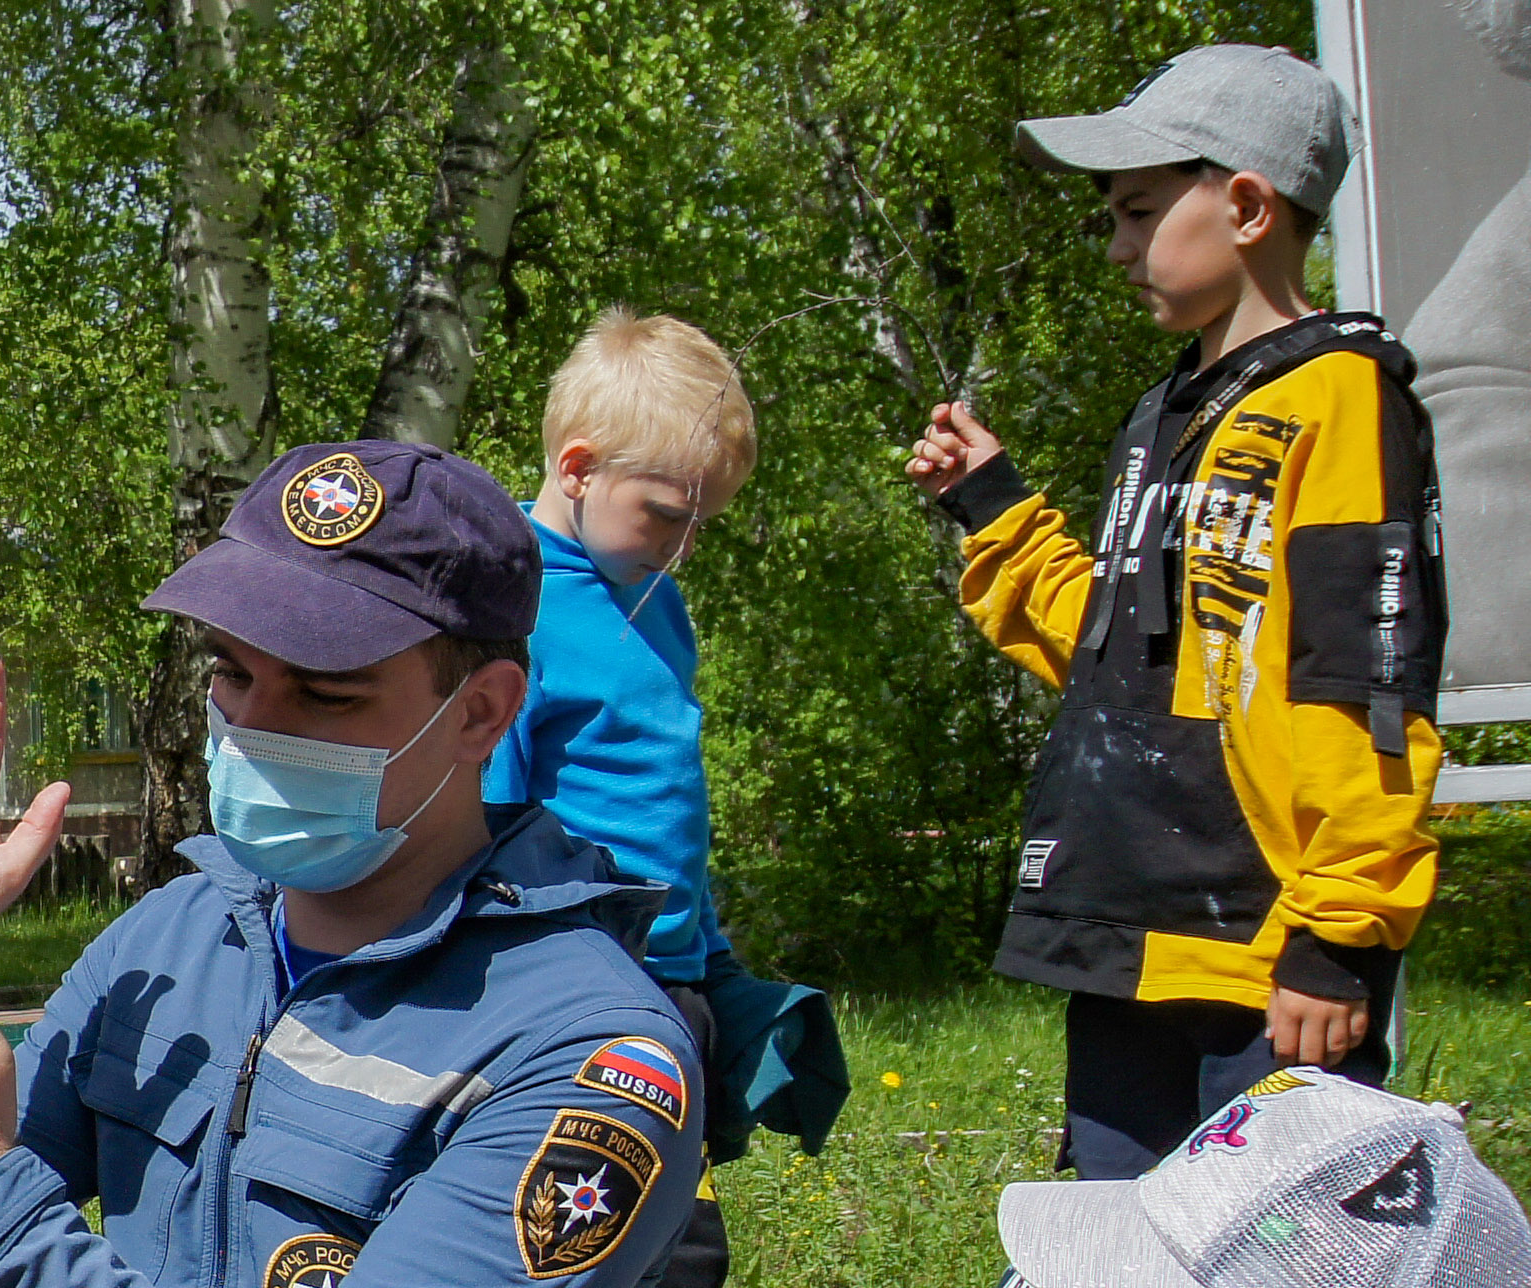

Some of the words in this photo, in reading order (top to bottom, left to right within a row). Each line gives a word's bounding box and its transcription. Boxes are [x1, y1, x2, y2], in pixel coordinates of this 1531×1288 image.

[307, 460, 337, 479] МЧС
[288, 490, 362, 538] EMERCOM
[600, 1066, 674, 1112] RUSSIA
[561, 1119, 604, 1141] МЧС
[606, 1130, 653, 1180] РОССИИ
[276, 1250, 309, 1281] МЧС
